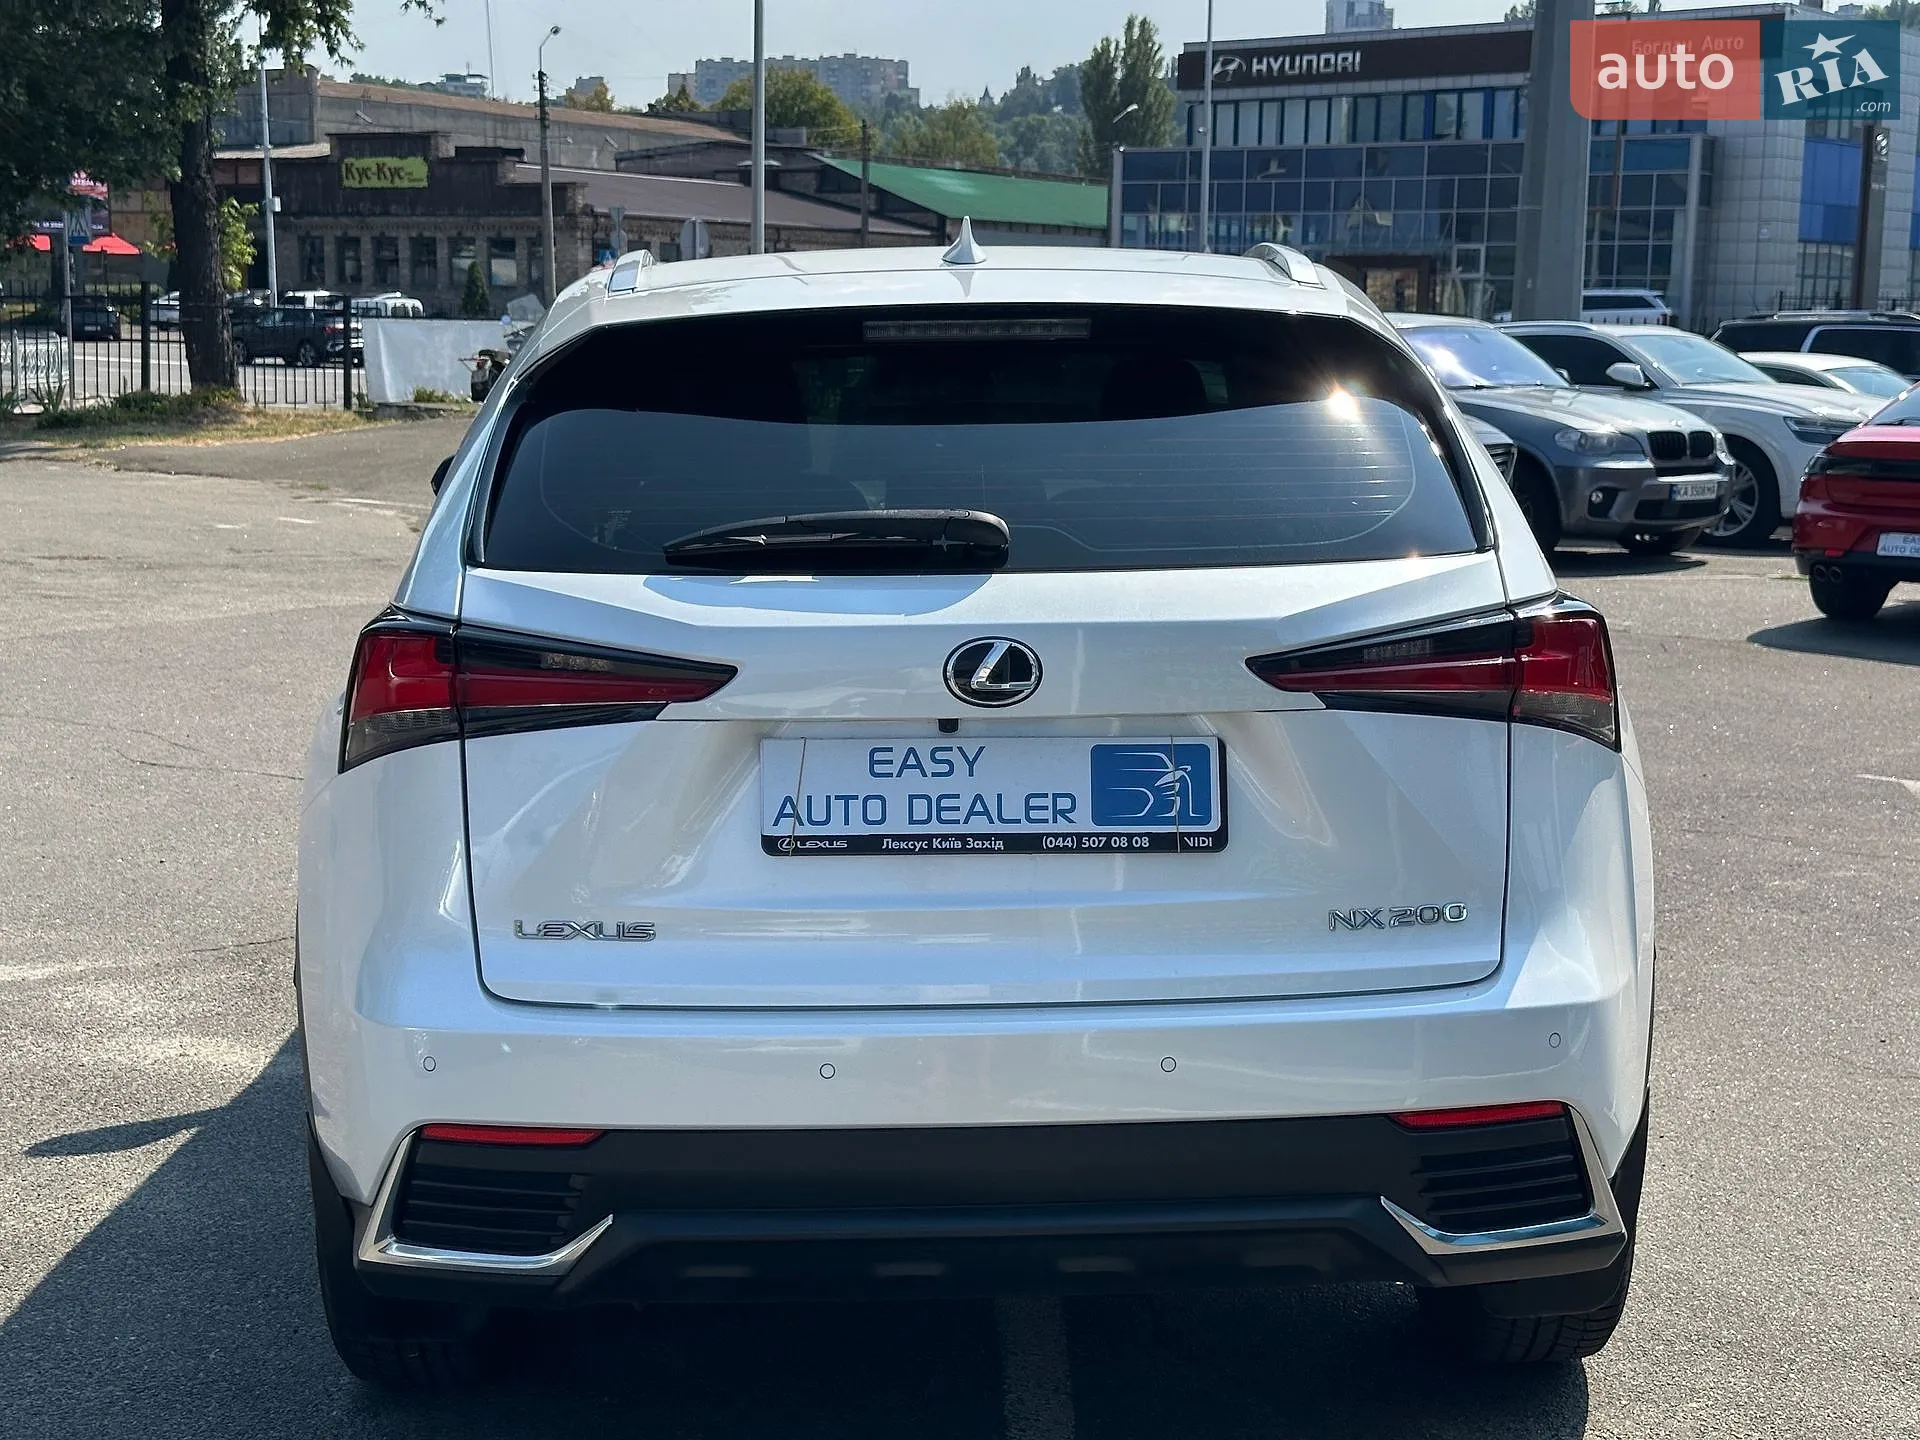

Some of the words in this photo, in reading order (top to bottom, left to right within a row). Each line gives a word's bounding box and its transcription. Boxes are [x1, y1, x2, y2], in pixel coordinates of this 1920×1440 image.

[1701, 33, 1745, 53] Авто
[1251, 50, 1363, 78] HYUNDAI
[344, 161, 405, 185] Кус-Кус
[868, 745, 986, 778] EASY
[772, 794, 887, 827] AUTO
[907, 792, 1077, 825] DEALER
[797, 840, 848, 849] LEXUS
[882, 838, 928, 851] Лексус
[932, 836, 962, 849] Київ
[965, 836, 1004, 851] Захід
[1042, 835, 1077, 849] (044)
[1081, 836, 1107, 848] 507
[1110, 836, 1129, 848] 08
[1132, 835, 1150, 848] 08
[1183, 836, 1213, 847] VIDI
[513, 919, 657, 942] LEXUS
